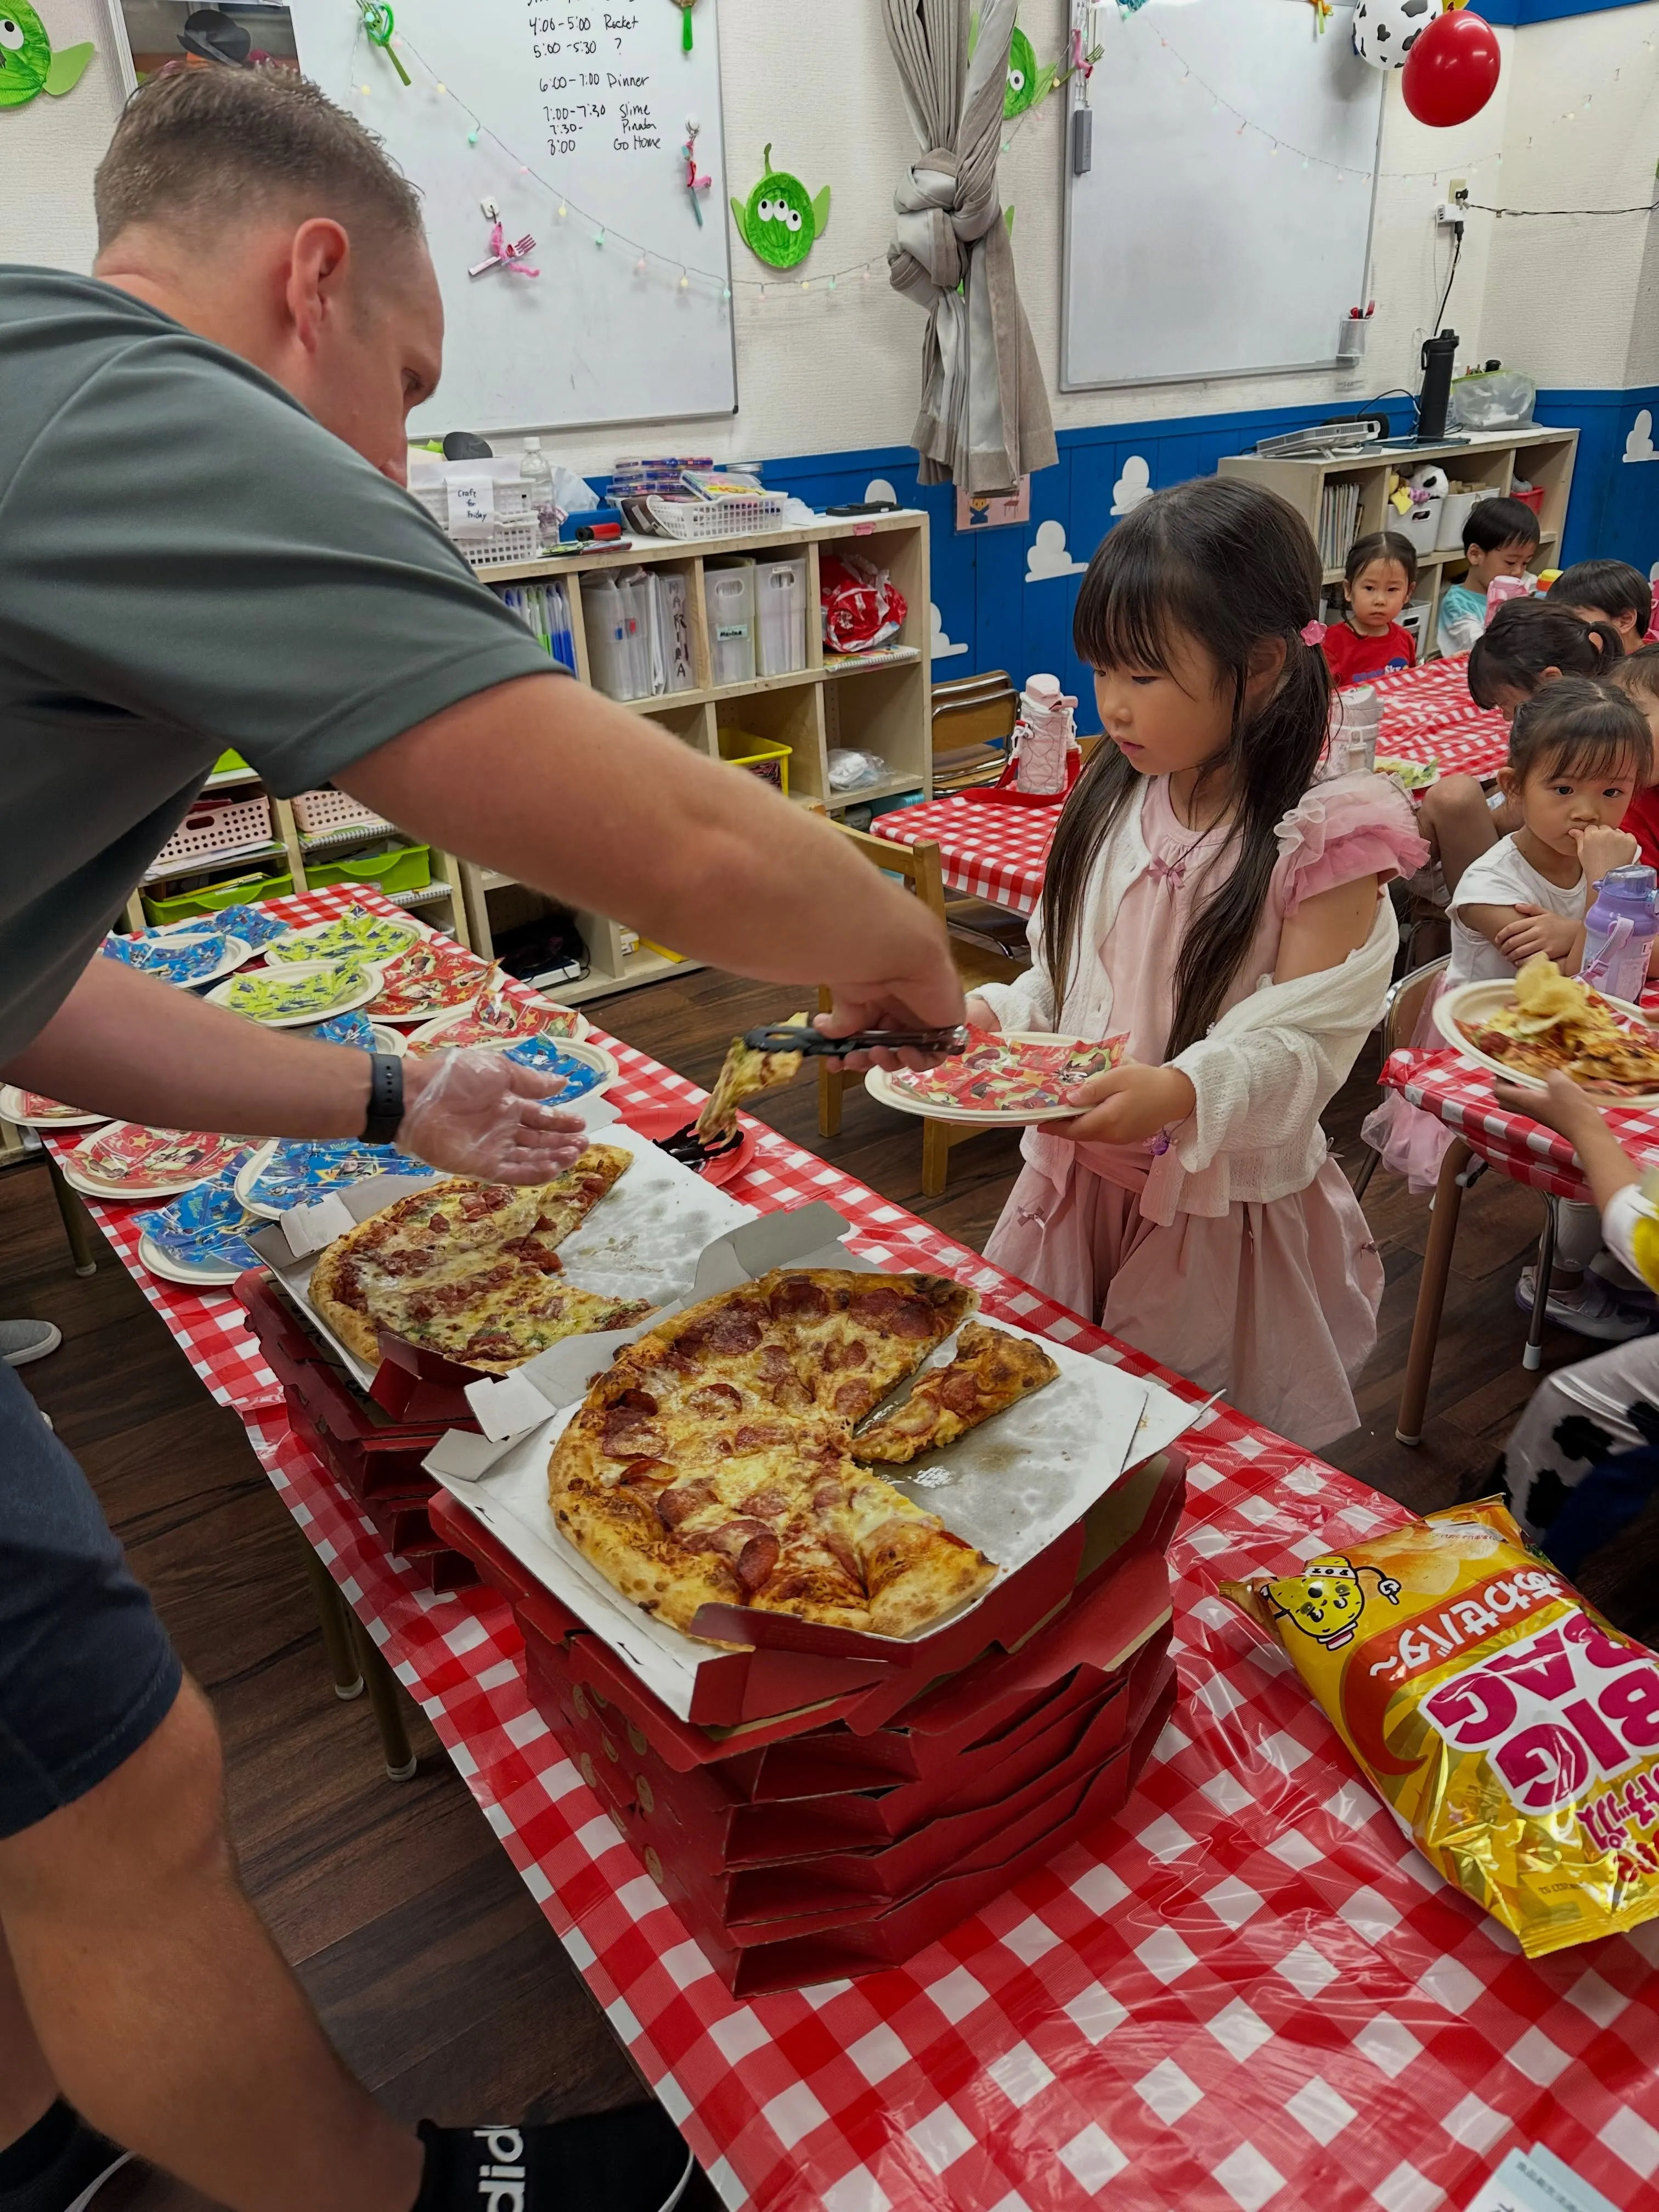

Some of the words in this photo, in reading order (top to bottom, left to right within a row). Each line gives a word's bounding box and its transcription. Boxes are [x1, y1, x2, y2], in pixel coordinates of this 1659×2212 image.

[603, 14, 639, 30] Rocket
[614, 38, 622, 55] ?
[607, 72, 649, 88] Dinner
[619, 101, 651, 119] Slime
[613, 138, 629, 150] Go
[634, 135, 661, 150] Home
[458, 488, 476, 498] Craft
[466, 498, 476, 506] for
[467, 510, 487, 522] Friday
[1426, 1613, 1640, 1744] BAG
[1494, 1667, 1659, 1808] BIG
